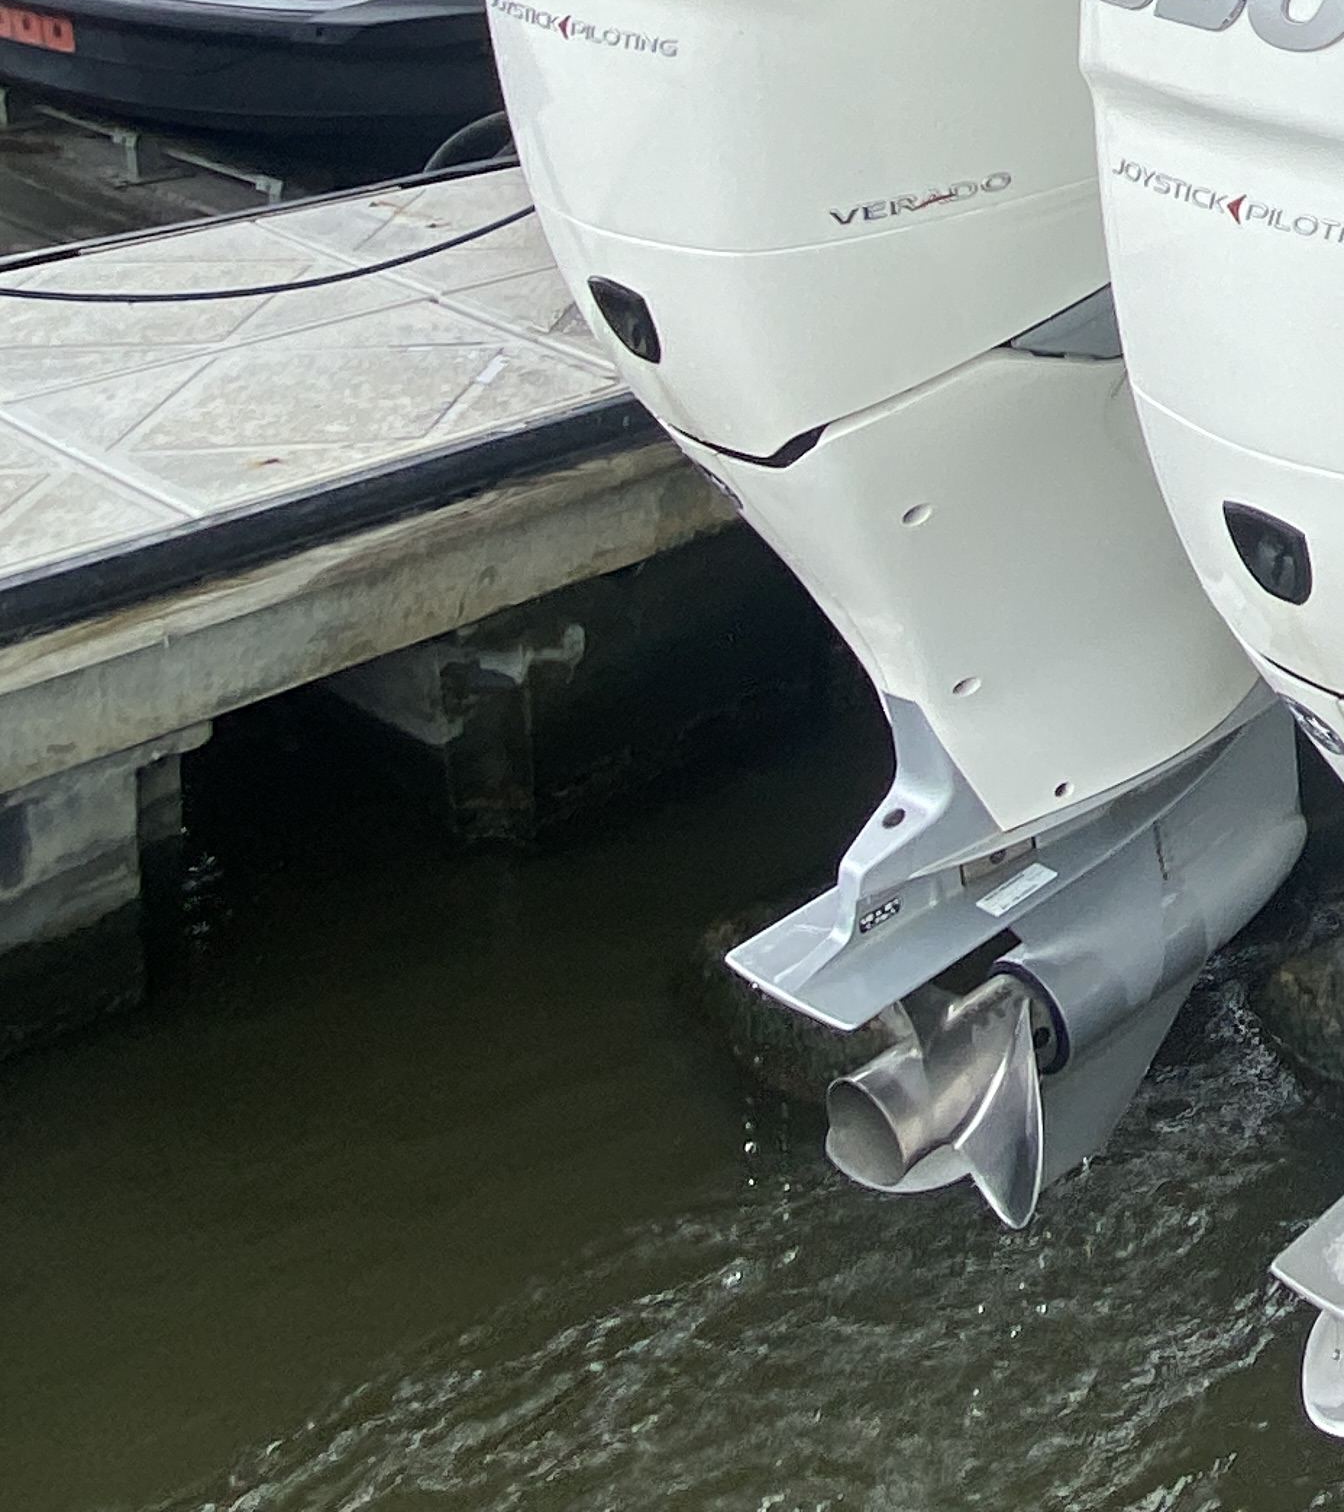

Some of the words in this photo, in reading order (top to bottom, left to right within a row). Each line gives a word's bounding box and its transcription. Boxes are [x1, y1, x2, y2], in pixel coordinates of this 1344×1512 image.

[570, 18, 680, 58] PILOTING
[829, 170, 1013, 226] VERADO
[1111, 156, 1229, 215] JOYSTICK
